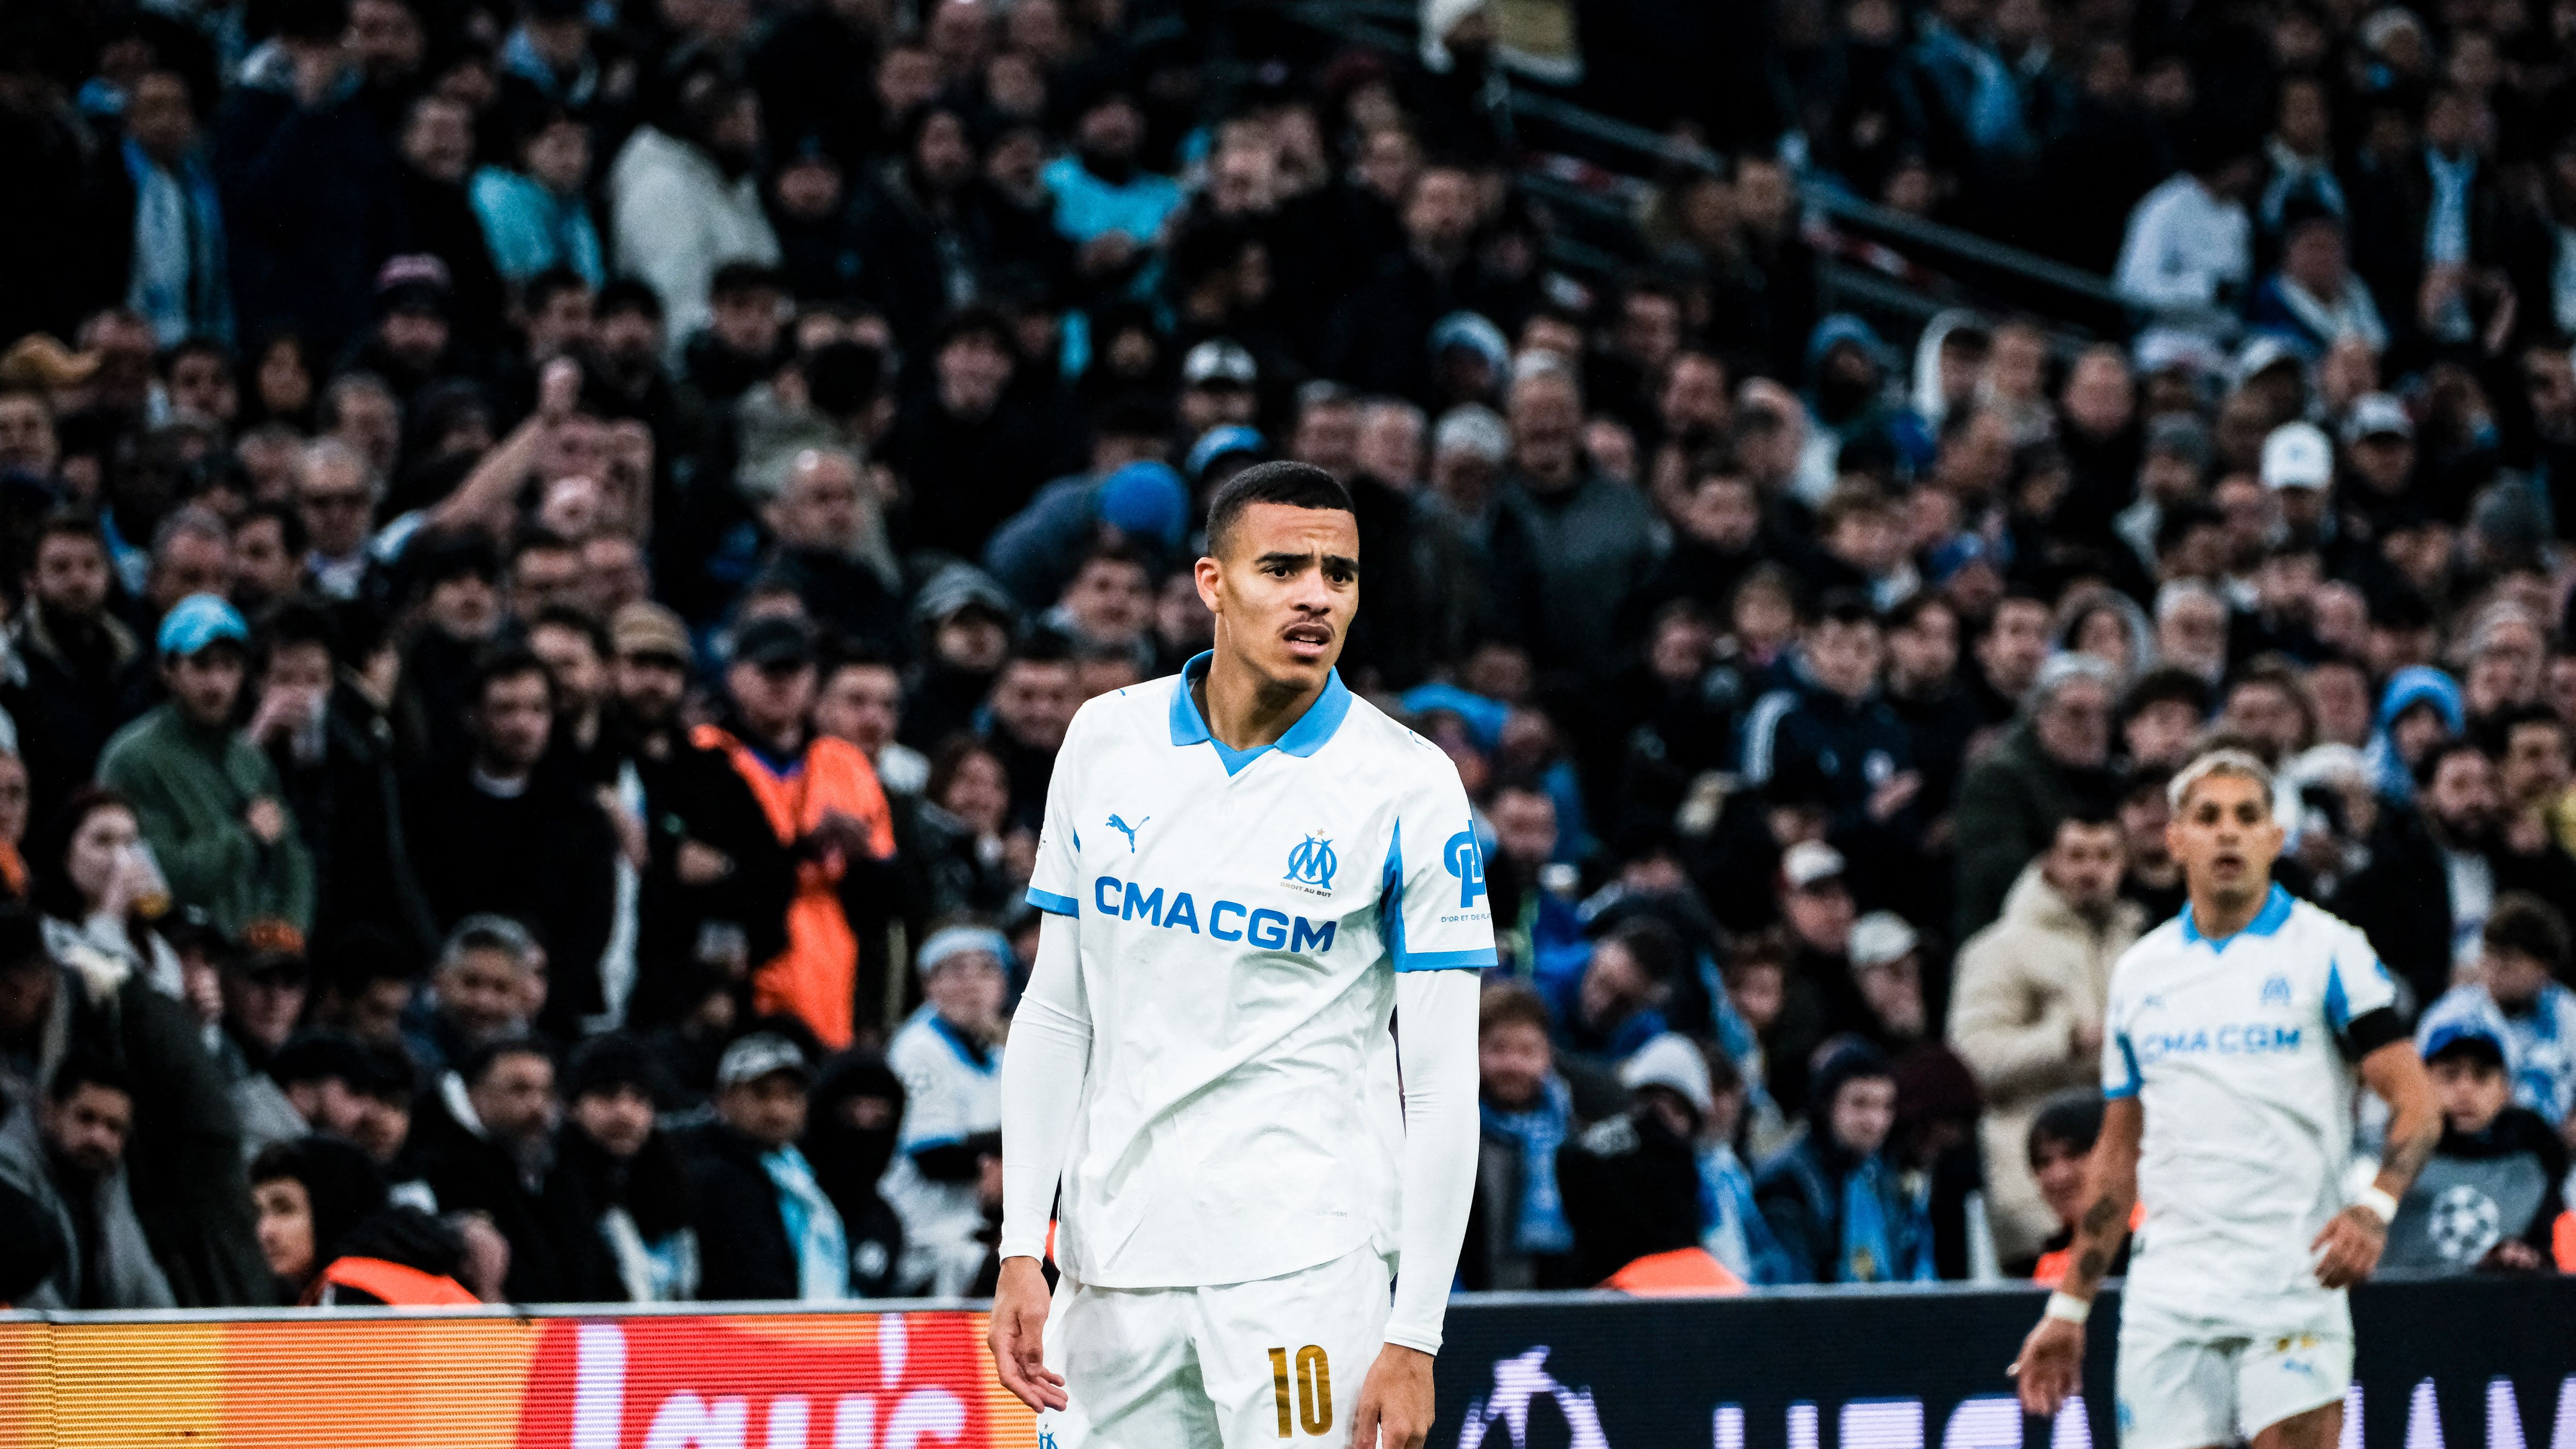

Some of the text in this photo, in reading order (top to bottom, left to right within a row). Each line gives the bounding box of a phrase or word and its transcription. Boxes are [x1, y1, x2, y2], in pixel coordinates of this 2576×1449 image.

[1095, 876, 1337, 953] CMA CGM
[1280, 881, 1303, 891] DROIT
[2142, 1025, 2302, 1063] CMA CGM
[1268, 1344, 1333, 1438] 10
